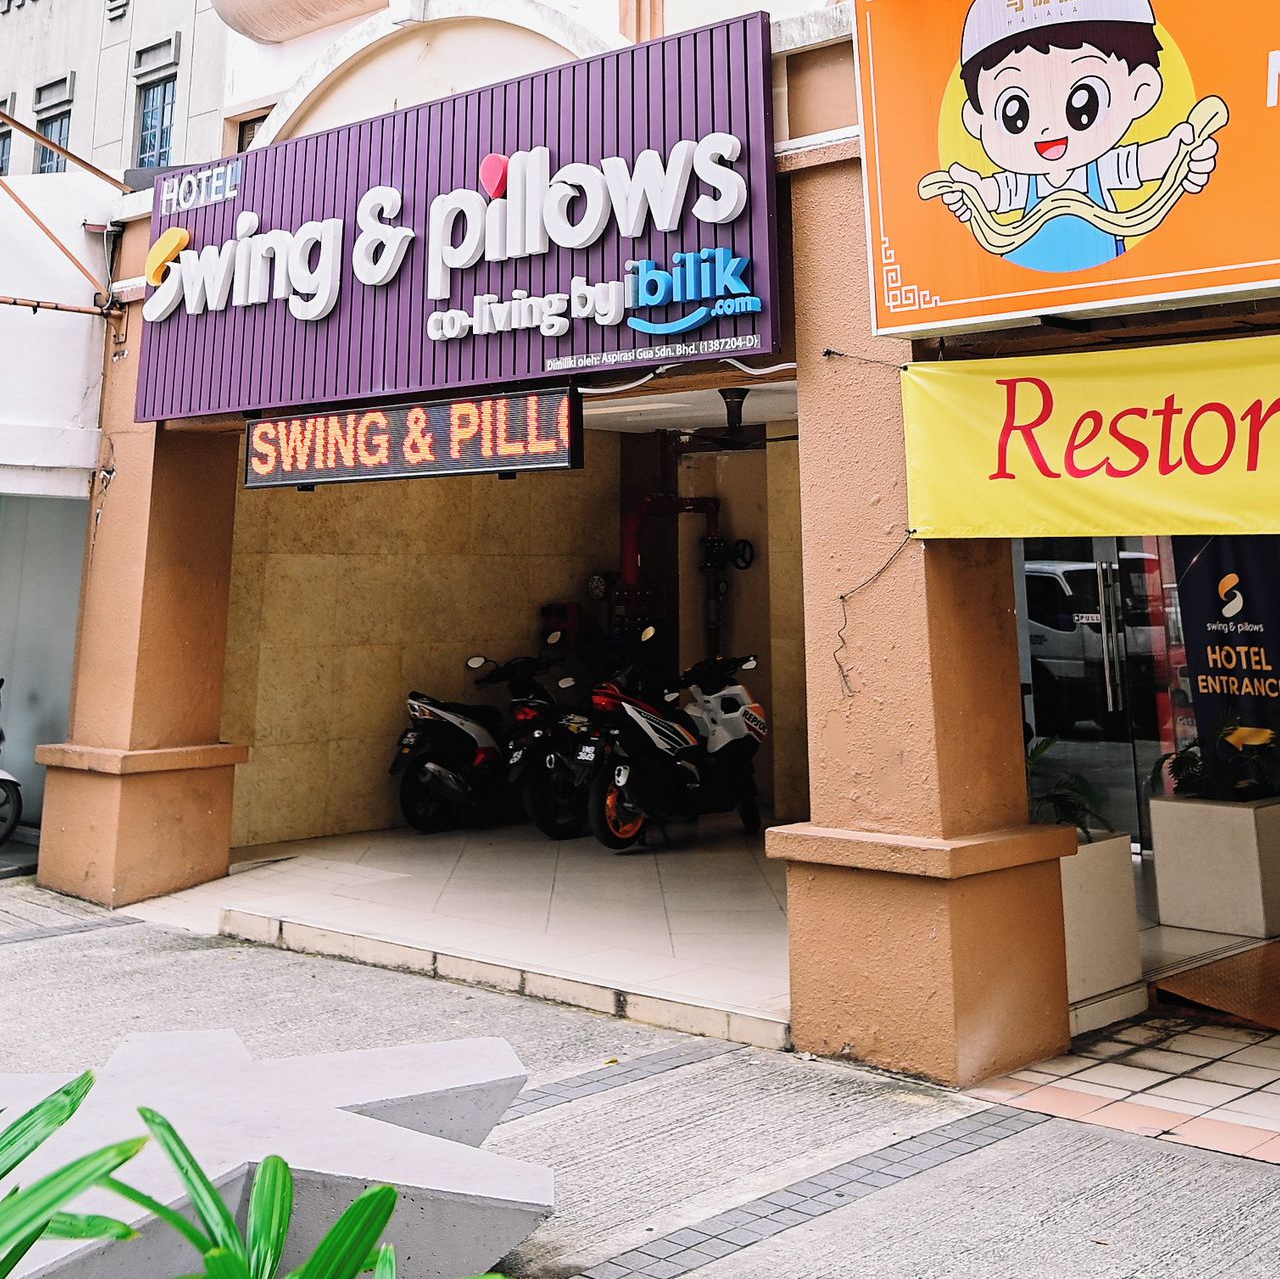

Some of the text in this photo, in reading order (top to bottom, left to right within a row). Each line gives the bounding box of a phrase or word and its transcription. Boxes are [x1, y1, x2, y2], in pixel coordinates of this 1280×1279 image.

[1007, 6, 1079, 27] MALALA
[161, 164, 238, 215] HOTEL
[352, 185, 416, 286] &
[428, 131, 747, 300] pillows
[426, 289, 570, 341] co-living
[571, 275, 624, 326] by
[547, 334, 758, 371] Dimiliki oleh: Aspirasi Gua Sdn. Bhd. (1387204-D)
[250, 411, 390, 476] SWING
[403, 408, 436, 463] &
[1206, 621, 1264, 633] swing & pillows
[1206, 645, 1273, 671] HOTEL
